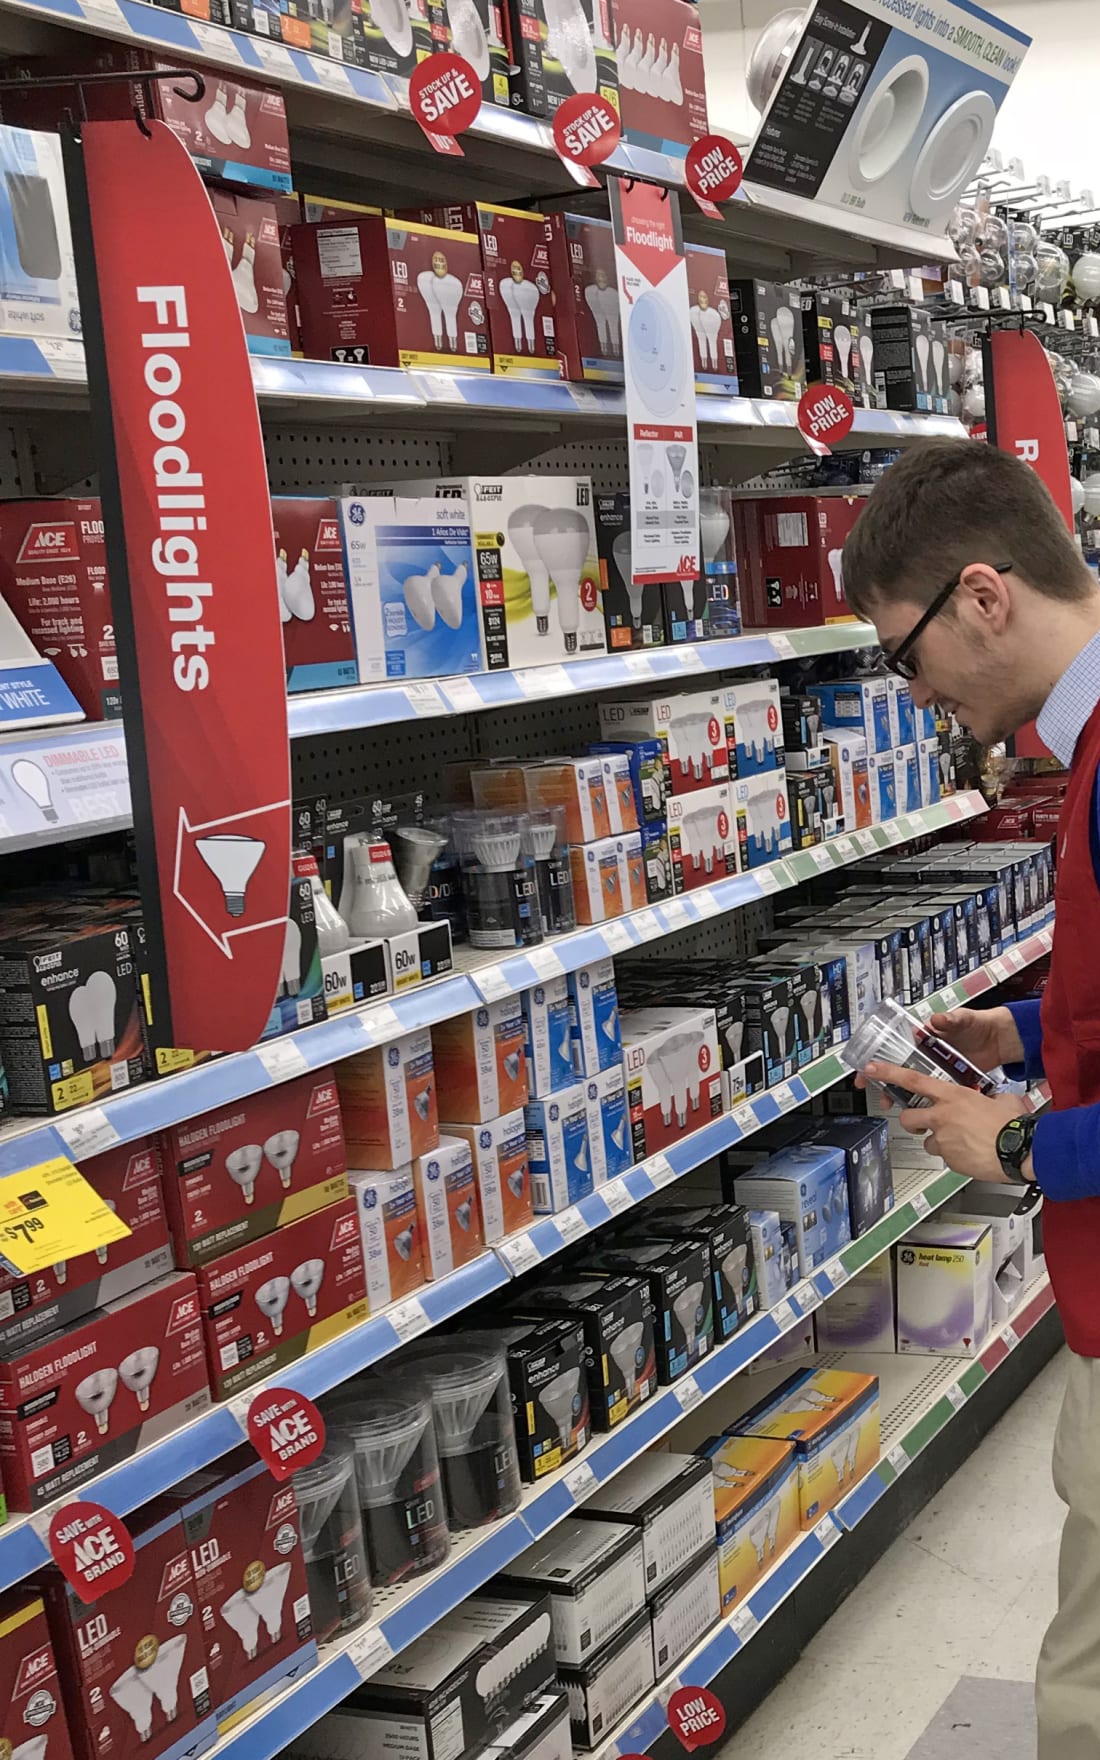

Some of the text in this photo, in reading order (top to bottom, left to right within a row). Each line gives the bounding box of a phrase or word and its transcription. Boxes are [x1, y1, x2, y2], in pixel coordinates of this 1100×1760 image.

[419, 81, 442, 99] STOCK
[442, 74, 452, 86] UP
[420, 74, 474, 122] SAVE
[562, 117, 584, 137] STOCK
[582, 110, 594, 124] UP
[564, 109, 615, 156] SAVE
[694, 147, 724, 178] LOW
[698, 157, 738, 194] PRICE
[449, 206, 464, 232] LED
[484, 234, 498, 251] LED
[626, 226, 674, 252] Floodlight
[392, 262, 408, 278] LED
[488, 278, 494, 288] 2
[398, 298, 404, 308] 2
[806, 394, 835, 420] LOW
[810, 404, 850, 436] PRICE
[136, 285, 216, 692] Floodlights
[576, 486, 590, 506] LED
[436, 512, 465, 520] soft white
[80, 521, 104, 534] FLOO
[324, 527, 338, 538] ACE
[34, 532, 65, 548] ACE
[677, 555, 696, 572] ACE
[586, 585, 593, 600] 2
[103, 625, 114, 640] 2
[724, 692, 736, 707] LED
[603, 708, 624, 722] LED
[656, 705, 671, 721] LED
[770, 710, 776, 723] 3
[711, 724, 718, 737] 3
[43, 744, 120, 767] DIMMABLE LED
[669, 802, 683, 818] LED
[778, 800, 784, 812] 3
[299, 812, 310, 826] 60
[326, 820, 348, 835] enhance
[720, 818, 726, 832] 3
[550, 871, 570, 886] LED
[299, 883, 310, 898] 60
[515, 882, 536, 898] LED
[114, 931, 129, 947] 60
[40, 968, 79, 986] enhance
[116, 962, 132, 978] LED
[160, 1052, 167, 1064] 2
[627, 1048, 645, 1072] LED
[701, 1052, 708, 1064] 3
[58, 1088, 65, 1100] 2
[315, 1088, 332, 1105] ACE
[178, 1113, 246, 1148] HALOGEN FLOODLIGHT
[134, 1157, 150, 1175] ACE
[194, 1210, 202, 1222] 2
[338, 1220, 354, 1236] ACE
[918, 1252, 934, 1261] heat
[935, 1254, 952, 1264] lamp
[952, 1254, 964, 1263] 250
[210, 1252, 274, 1291] HALOGEN FLOODLIGHT
[36, 1280, 45, 1292] 2
[666, 1276, 688, 1294] enhance
[22, 1305, 60, 1332] REPLACEMENT
[176, 1300, 194, 1320] ACE
[602, 1317, 625, 1336] enhance
[256, 1332, 265, 1343] 2
[18, 1341, 97, 1390] HALOGEN FLOODLIGHT
[528, 1362, 560, 1384] enhance
[253, 1403, 283, 1428] SAVE
[77, 1431, 87, 1445] 2
[270, 1410, 312, 1452] ACE
[278, 1432, 318, 1462] BRAND
[62, 1455, 100, 1484] REPLACEMENT
[276, 1492, 293, 1513] ACE
[406, 1500, 434, 1530] LED
[56, 1518, 87, 1544] SAVE
[74, 1527, 120, 1572] ACE
[192, 1538, 220, 1571] LED
[84, 1552, 126, 1582] BRAND
[169, 1558, 188, 1582] ACE
[334, 1554, 359, 1586] LED
[202, 1606, 213, 1622] 2
[77, 1613, 108, 1651] LED
[26, 1653, 49, 1680] ACE
[90, 1686, 102, 1704] 2
[677, 1697, 706, 1721] LOW
[679, 1708, 720, 1736] PRICE
